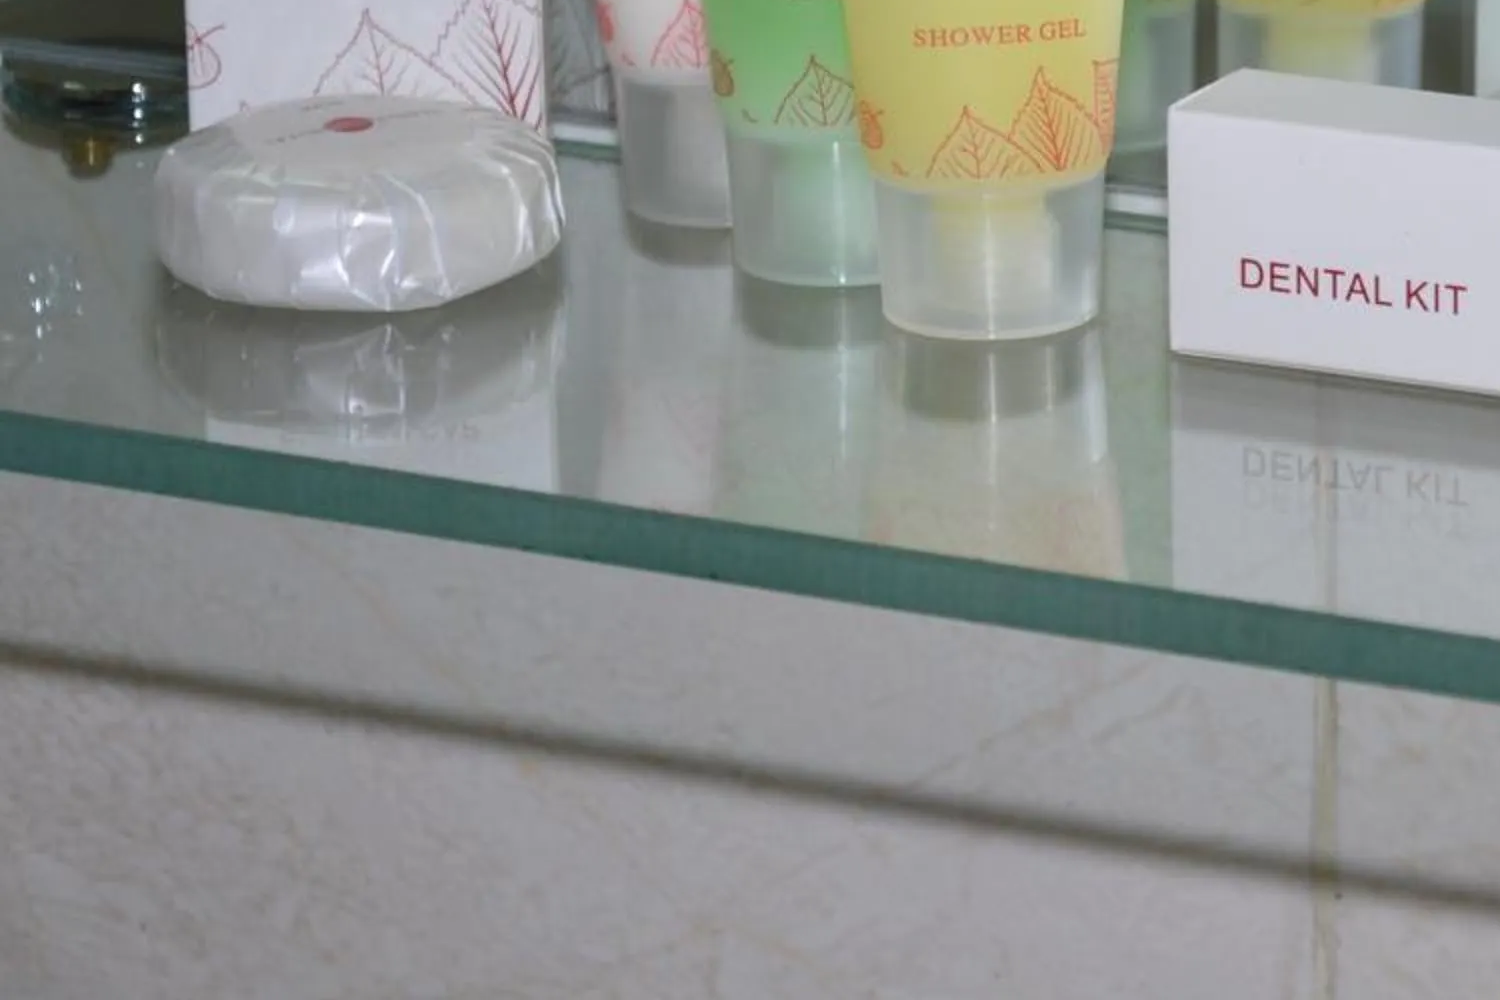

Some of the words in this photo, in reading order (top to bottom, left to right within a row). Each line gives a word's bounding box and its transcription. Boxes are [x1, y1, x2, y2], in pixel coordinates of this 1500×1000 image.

[912, 23, 1034, 49] SHOWER
[1038, 17, 1087, 43] GEL
[1238, 256, 1392, 309] DENTAL
[1404, 278, 1469, 317] KIT
